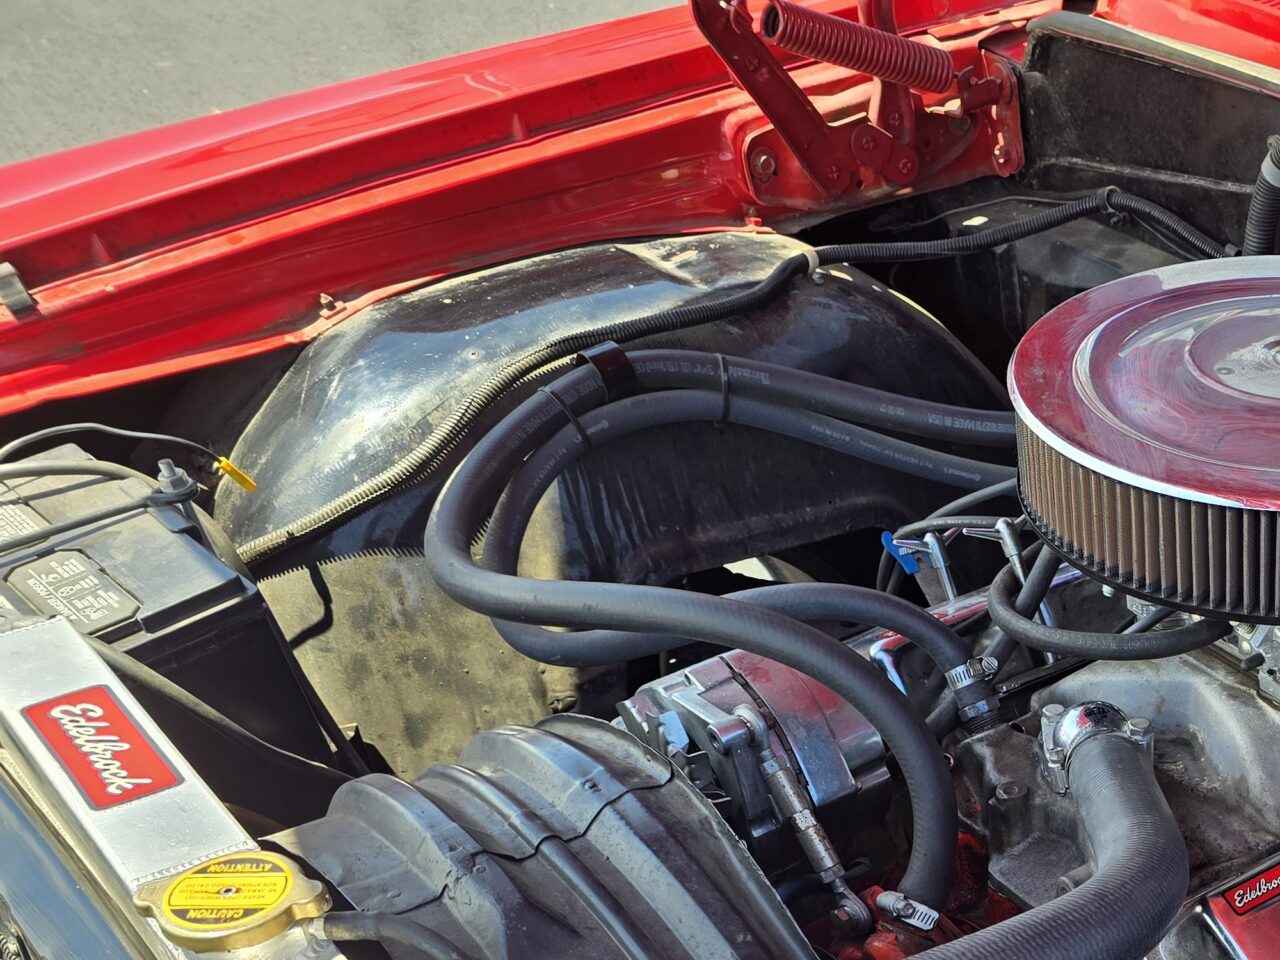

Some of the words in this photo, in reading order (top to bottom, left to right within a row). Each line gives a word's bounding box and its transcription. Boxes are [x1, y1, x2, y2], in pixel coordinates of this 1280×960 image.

[50, 703, 153, 794] Edelbrock
[207, 863, 273, 873] ATTENTION
[186, 908, 244, 919] CAUTION
